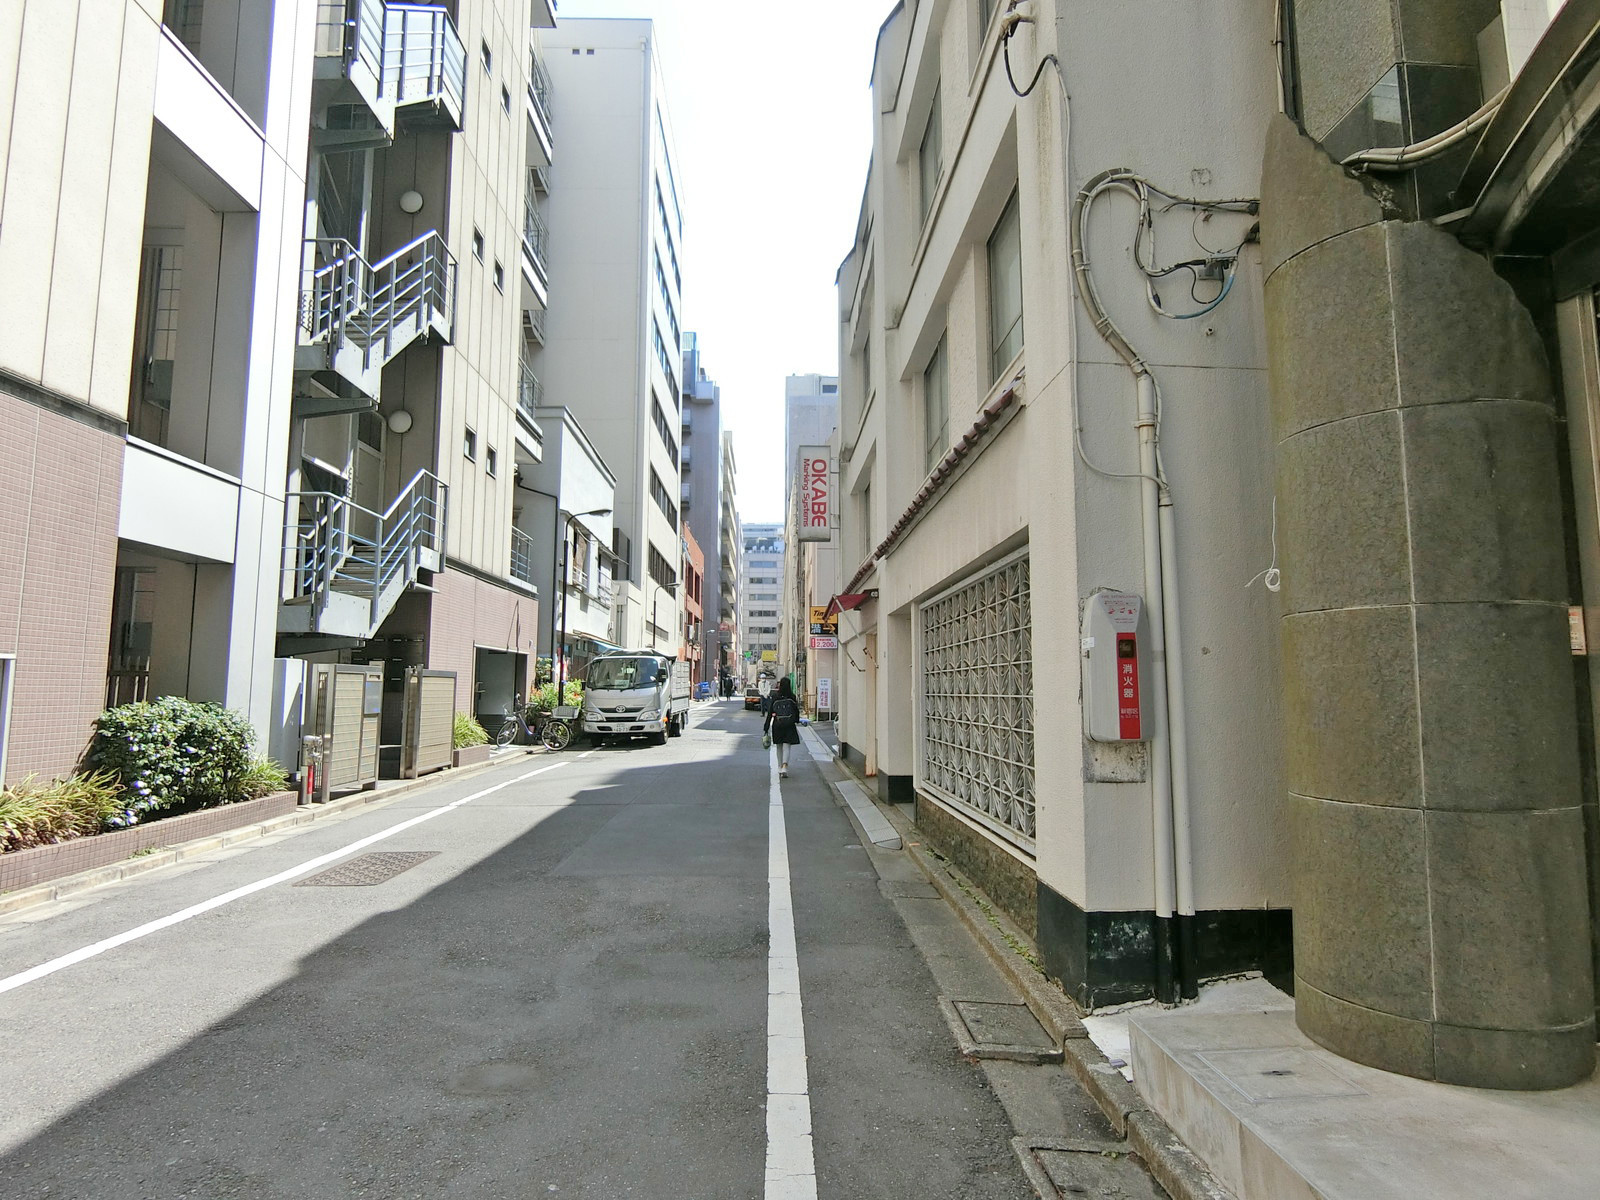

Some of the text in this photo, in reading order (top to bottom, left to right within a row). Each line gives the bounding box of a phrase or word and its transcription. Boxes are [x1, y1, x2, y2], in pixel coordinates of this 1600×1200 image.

[802, 459, 810, 527] Marking Systems
[812, 459, 827, 527] OKABE
[1123, 664, 1134, 698] 消火器
